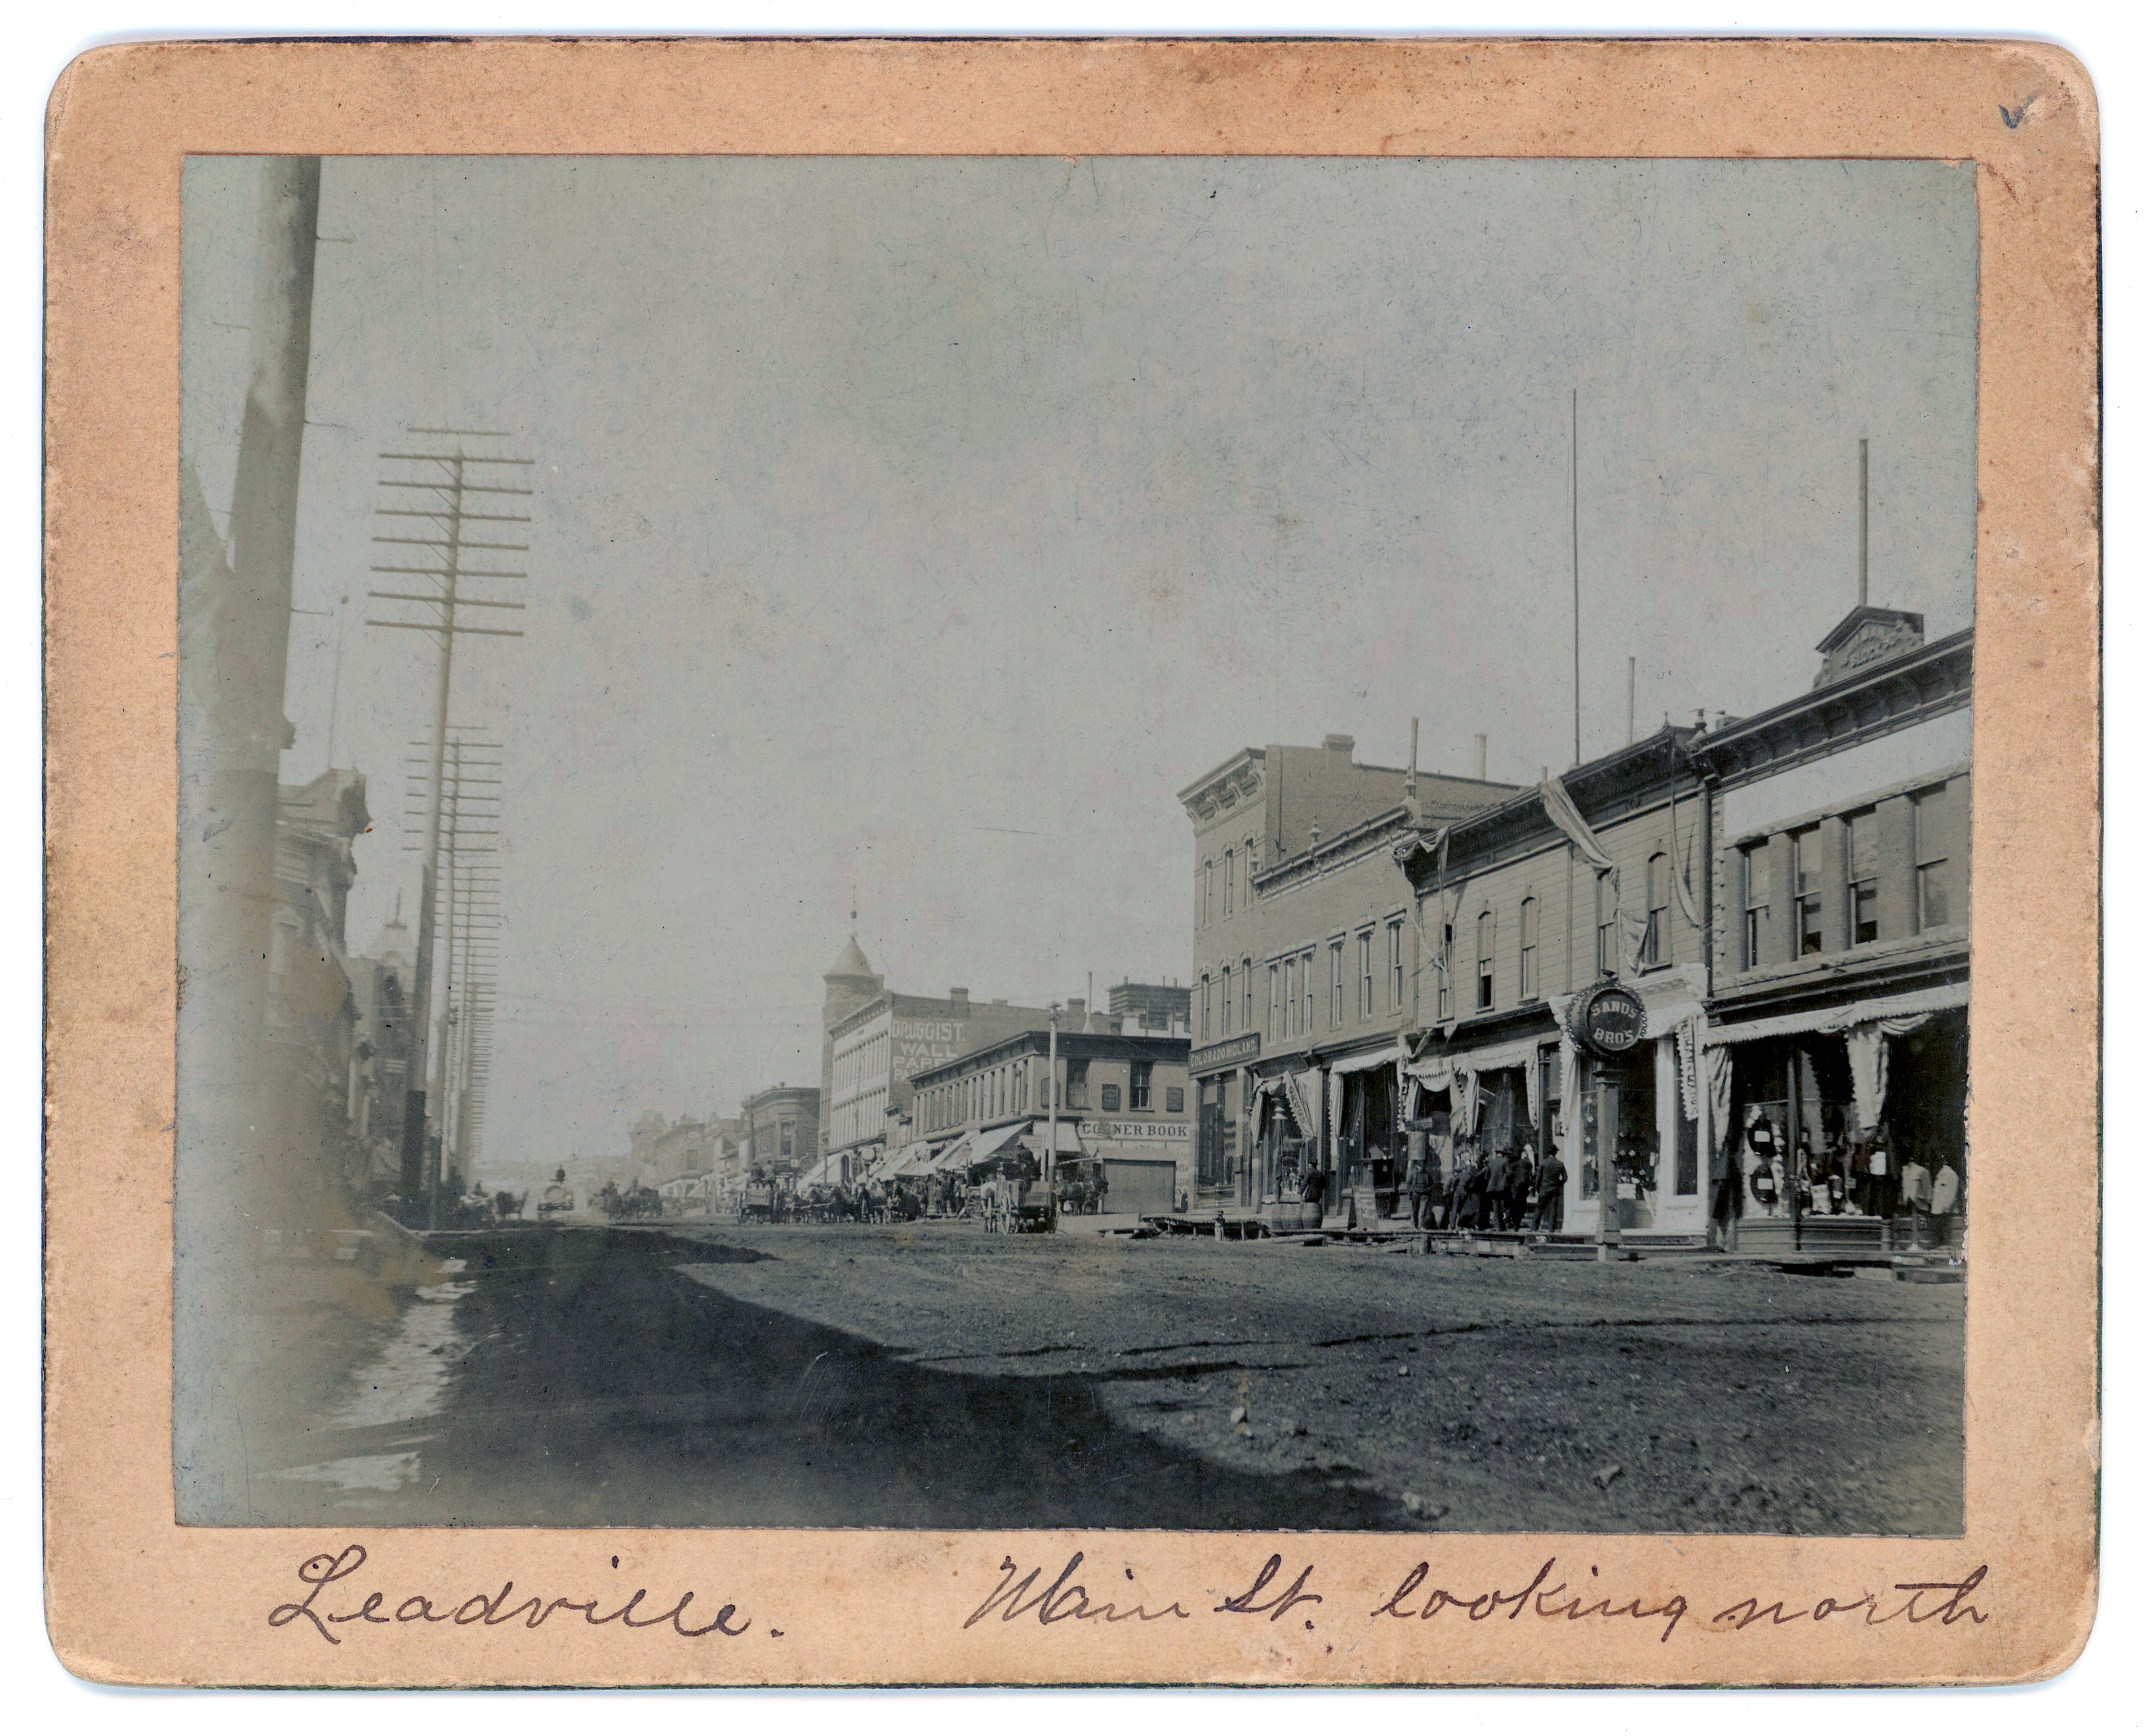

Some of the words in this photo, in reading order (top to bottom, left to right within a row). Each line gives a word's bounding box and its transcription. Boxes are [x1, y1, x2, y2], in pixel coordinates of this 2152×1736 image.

[1591, 1000, 1638, 1019] SANDS
[892, 1019, 965, 1042] DRUGGIST.
[900, 1042, 958, 1057] WALL
[1191, 1047, 1225, 1067] COLORADO
[1226, 1040, 1258, 1058] MIDLAND.
[893, 1055, 953, 1068] PAPE
[1083, 1123, 1143, 1135] CONER
[1147, 1125, 1187, 1137] BOOK
[268, 1544, 786, 1645] Leadville.
[963, 1551, 1189, 1628] Main
[1214, 1554, 1323, 1630] St.
[1371, 1556, 1688, 1643] looking
[1713, 1565, 1989, 1631] north
